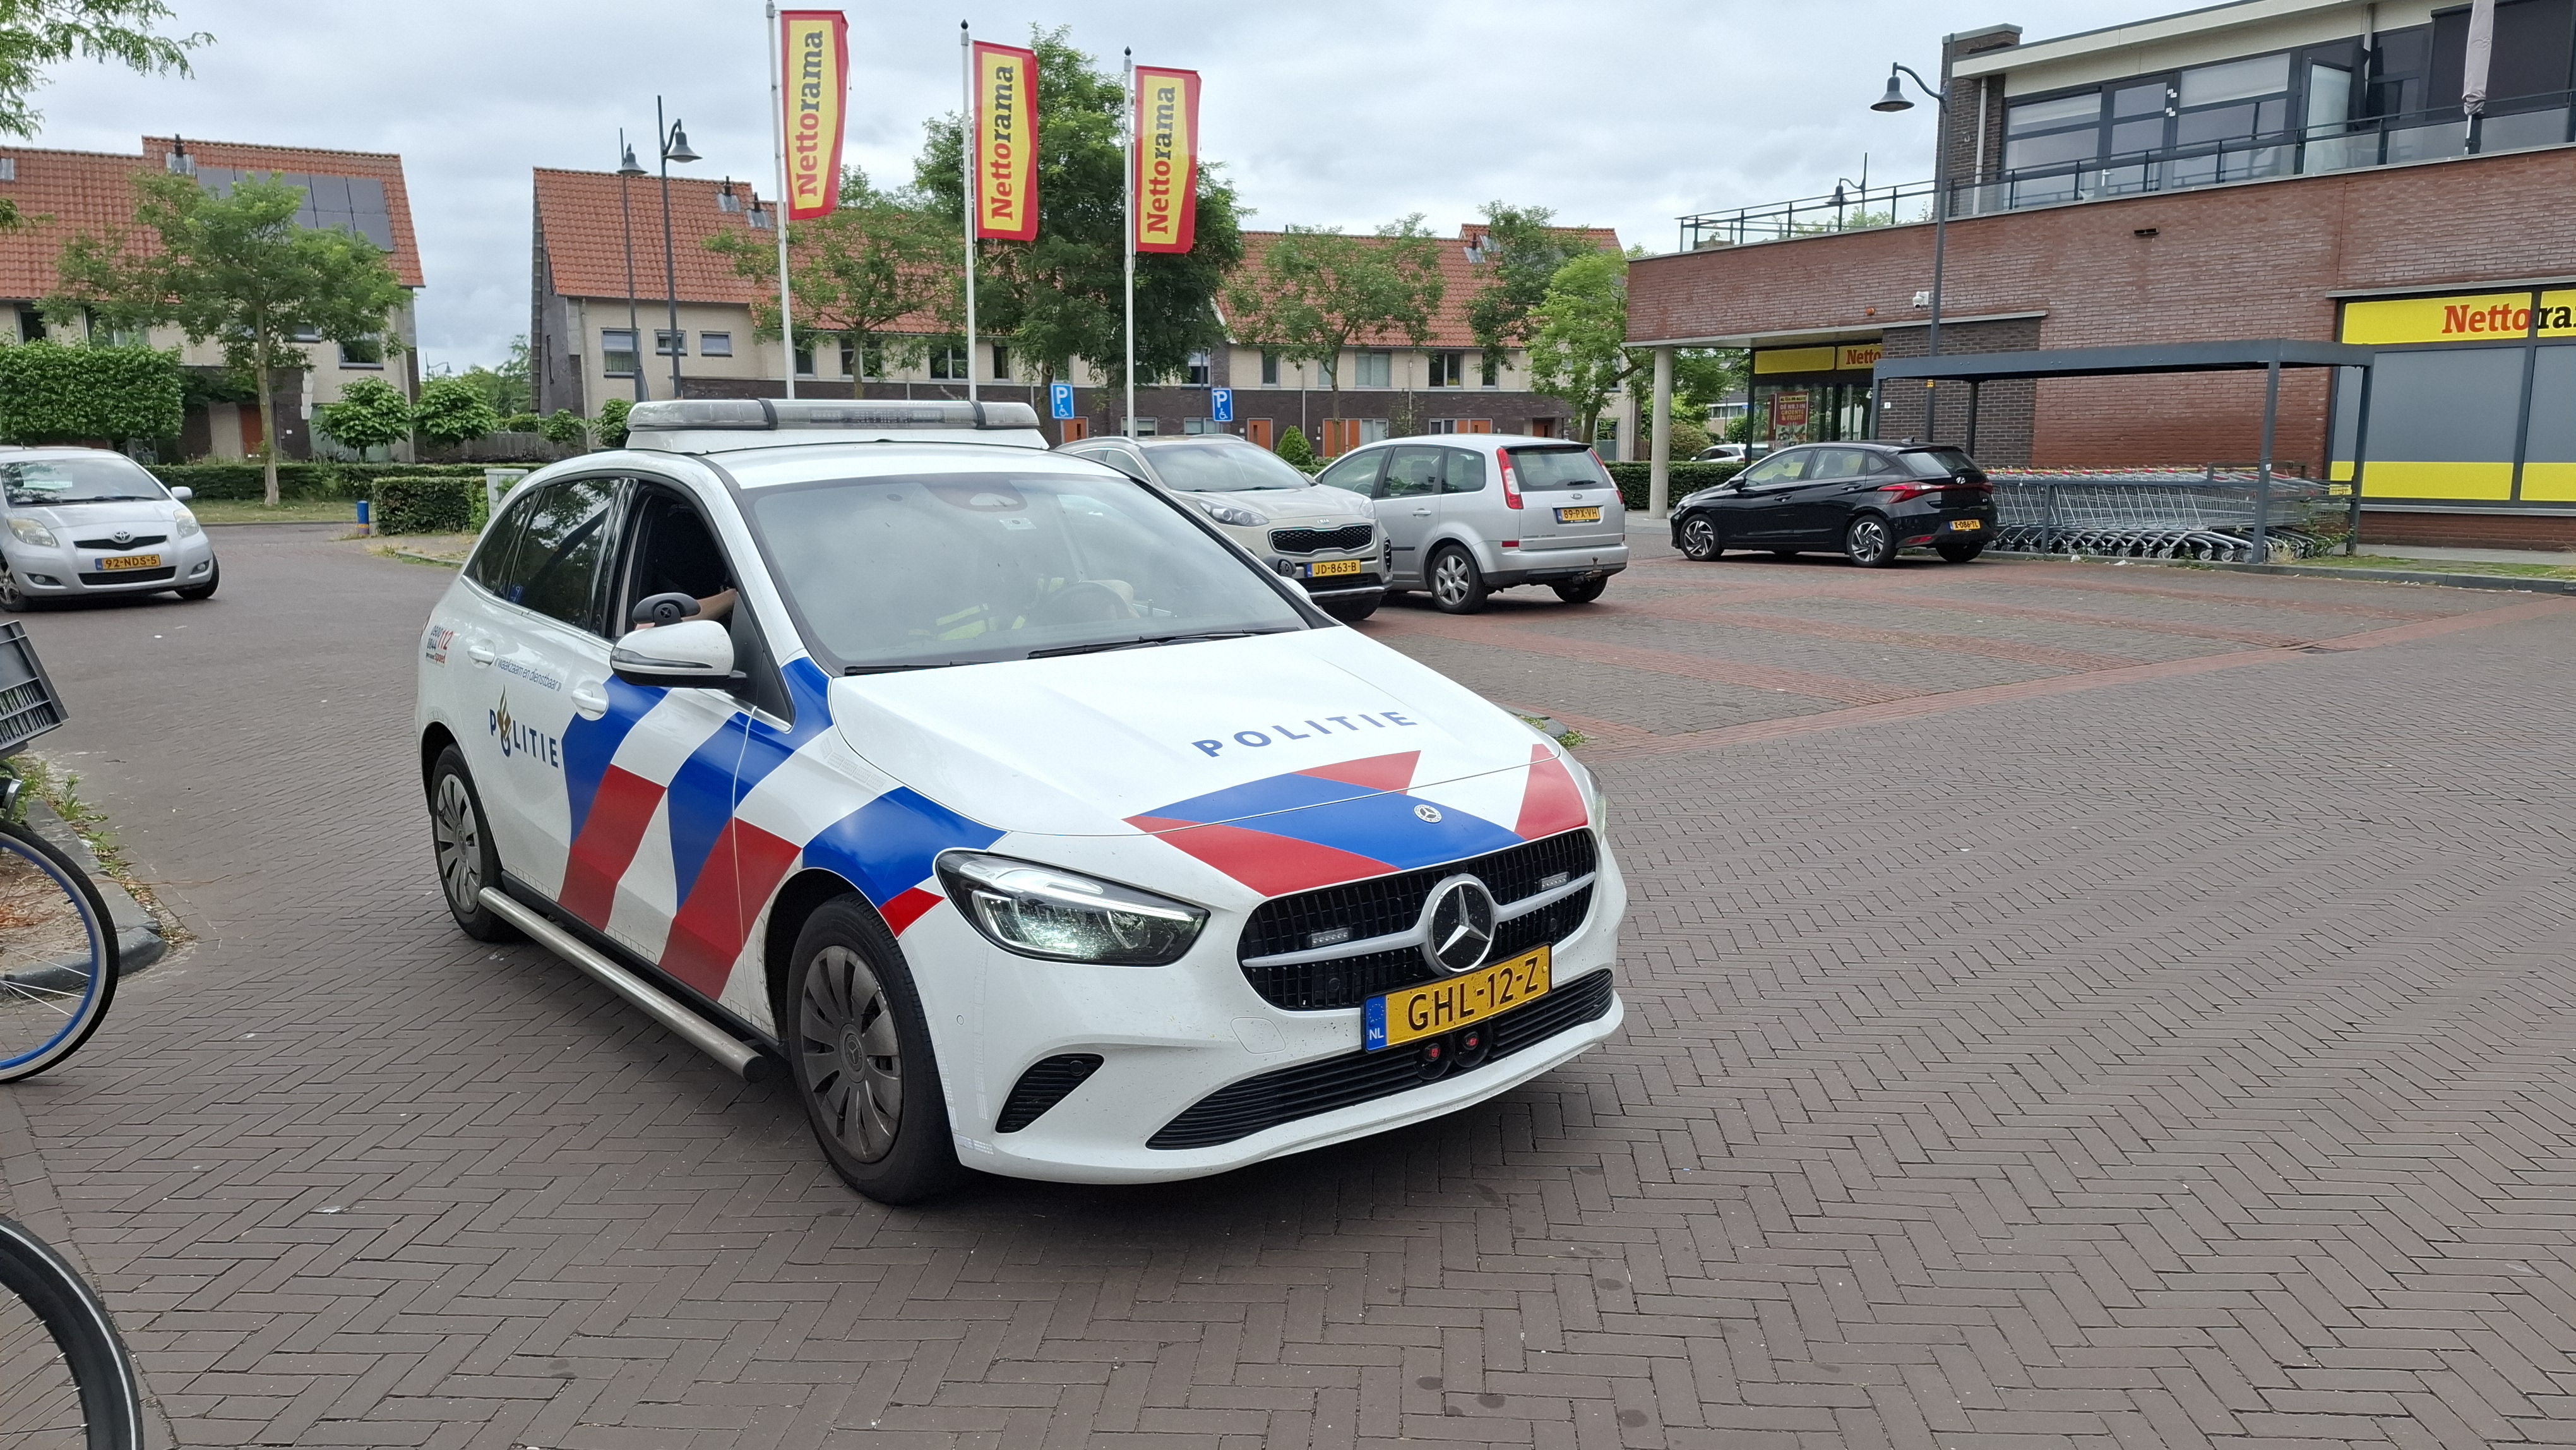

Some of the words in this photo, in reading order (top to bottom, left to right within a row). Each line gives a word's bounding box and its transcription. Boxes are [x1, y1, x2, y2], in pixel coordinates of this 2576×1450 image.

[795, 30, 823, 198] Nettorama
[991, 66, 1014, 221] Nettorama
[1147, 87, 1176, 235] Nettorama
[2442, 303, 2576, 334] Nettora
[1056, 386, 1068, 404] P
[1216, 391, 1227, 408] P
[1563, 508, 1598, 519] 89-PX-VH
[105, 556, 157, 569] 92-NDS-5
[1315, 561, 1357, 575] JD-863-B
[438, 629, 454, 651] 112
[498, 659, 524, 677] waakzaam
[522, 669, 530, 680] en
[529, 668, 558, 690] dienstbaar
[489, 708, 559, 769] POLITIE
[1191, 711, 1418, 758] POLITIE
[1407, 956, 1539, 1031] GHL-12-Z
[1369, 1027, 1384, 1041] NL
